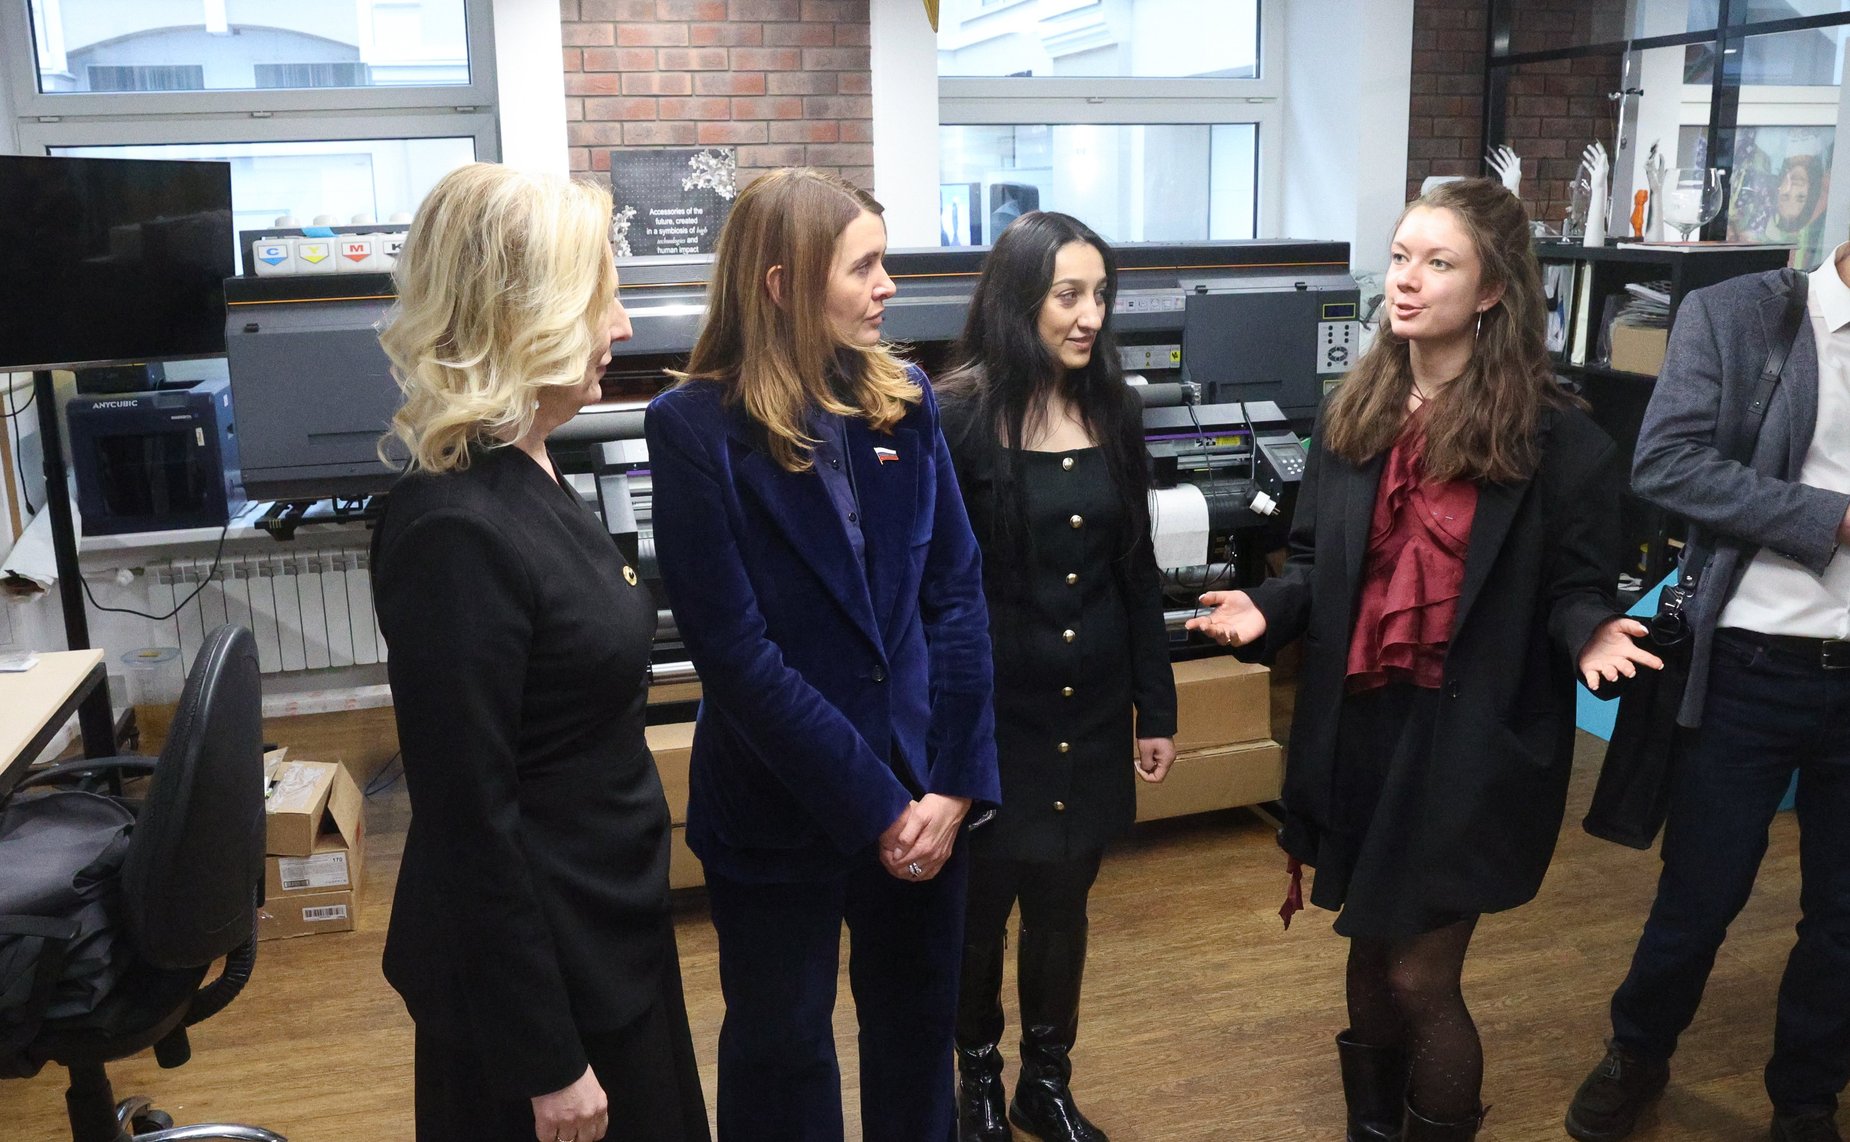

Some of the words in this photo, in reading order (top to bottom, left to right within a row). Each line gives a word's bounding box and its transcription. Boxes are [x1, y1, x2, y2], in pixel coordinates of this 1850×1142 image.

[649, 208, 685, 216] Accessories
[686, 207, 693, 215] of
[693, 207, 703, 215] the
[675, 217, 698, 225] created
[646, 227, 652, 235] in
[659, 226, 688, 236] symbiosis
[689, 226, 695, 234] of
[687, 236, 698, 244] and
[307, 246, 320, 254] Y
[350, 244, 364, 252] M
[391, 243, 402, 251] K
[657, 246, 678, 254] human
[679, 246, 699, 255] impact
[266, 247, 279, 256] C
[92, 400, 138, 409] ANYCUBIC
